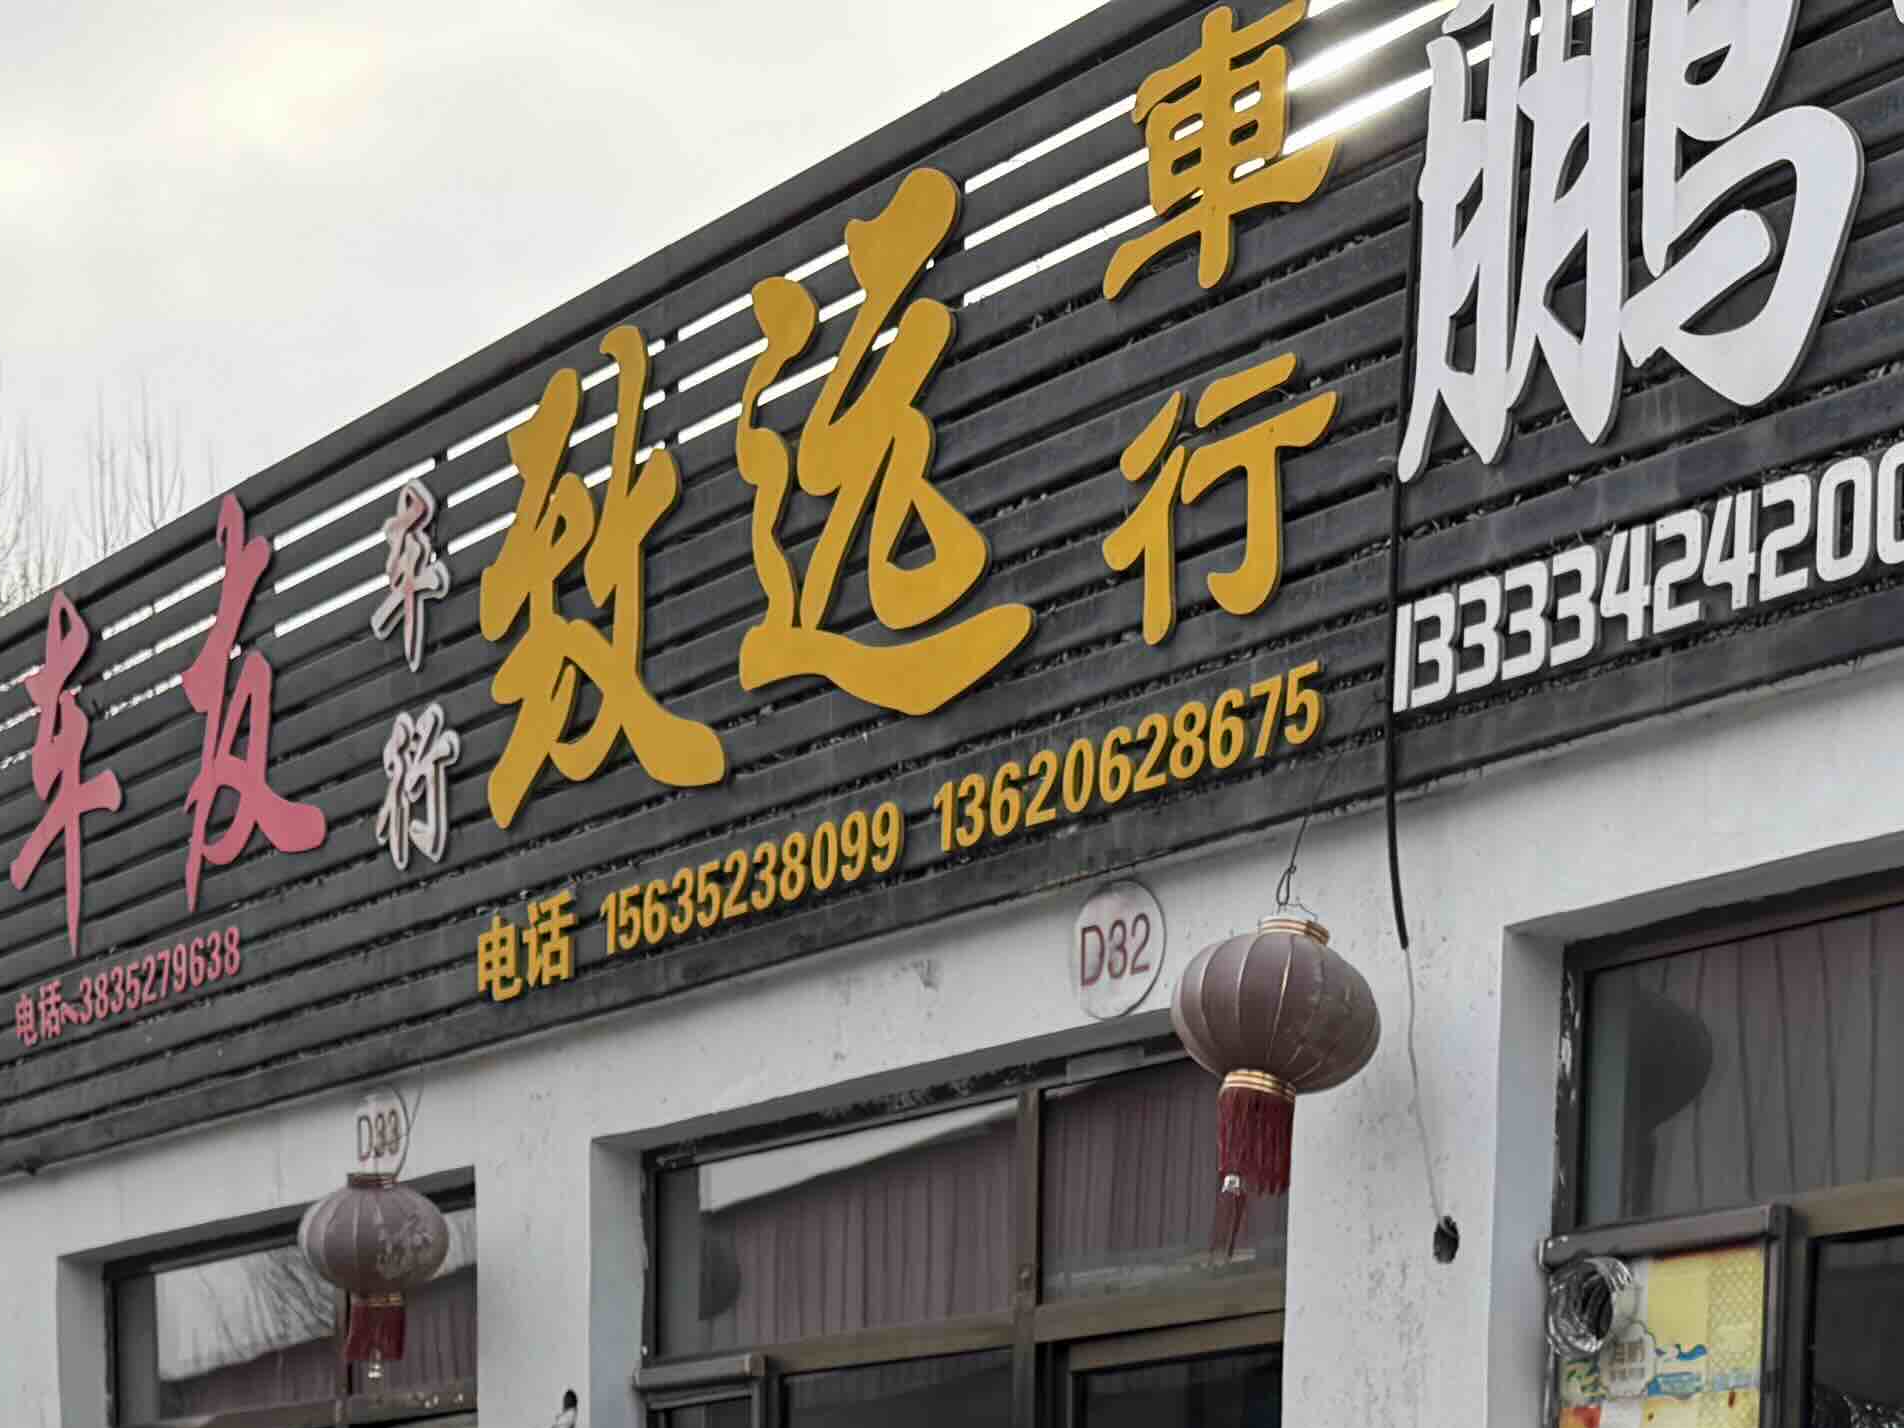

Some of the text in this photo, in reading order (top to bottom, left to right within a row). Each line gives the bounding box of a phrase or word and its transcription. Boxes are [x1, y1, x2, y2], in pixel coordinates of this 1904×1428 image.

[477, 660, 1322, 1002] 电话 15635238099 13620628675
[1080, 912, 1152, 988] D32
